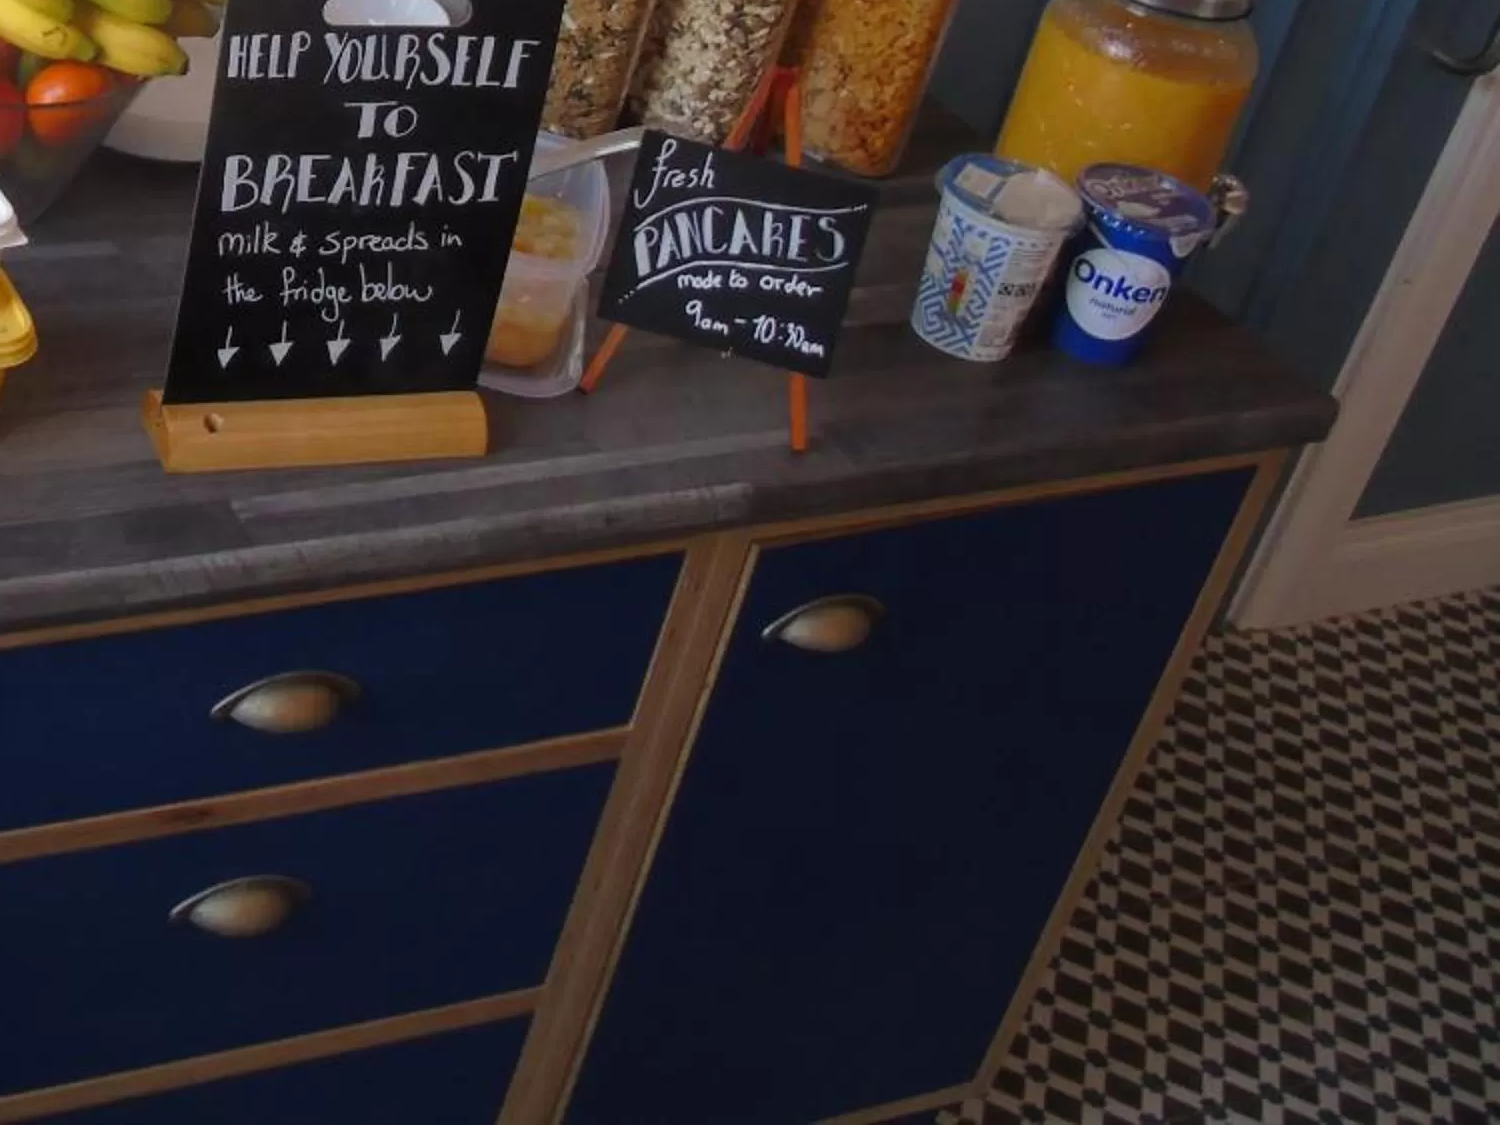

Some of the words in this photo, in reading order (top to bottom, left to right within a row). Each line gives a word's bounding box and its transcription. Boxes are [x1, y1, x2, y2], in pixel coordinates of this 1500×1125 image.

[227, 31, 311, 79] HELP
[323, 32, 540, 89] YOURSELF
[343, 100, 418, 139] TO
[221, 151, 518, 214] BREAKFAST
[634, 139, 715, 209] fresh
[218, 220, 281, 258] milk
[318, 220, 429, 265] spreads
[441, 224, 463, 247] in
[633, 206, 845, 276] PANCAKES
[223, 272, 264, 305] the
[279, 266, 352, 322] fridge
[360, 261, 432, 302] below
[677, 269, 722, 289] made
[729, 269, 748, 289] to
[759, 273, 824, 297] order
[1075, 258, 1168, 304] Onken
[685, 299, 729, 335] 9am
